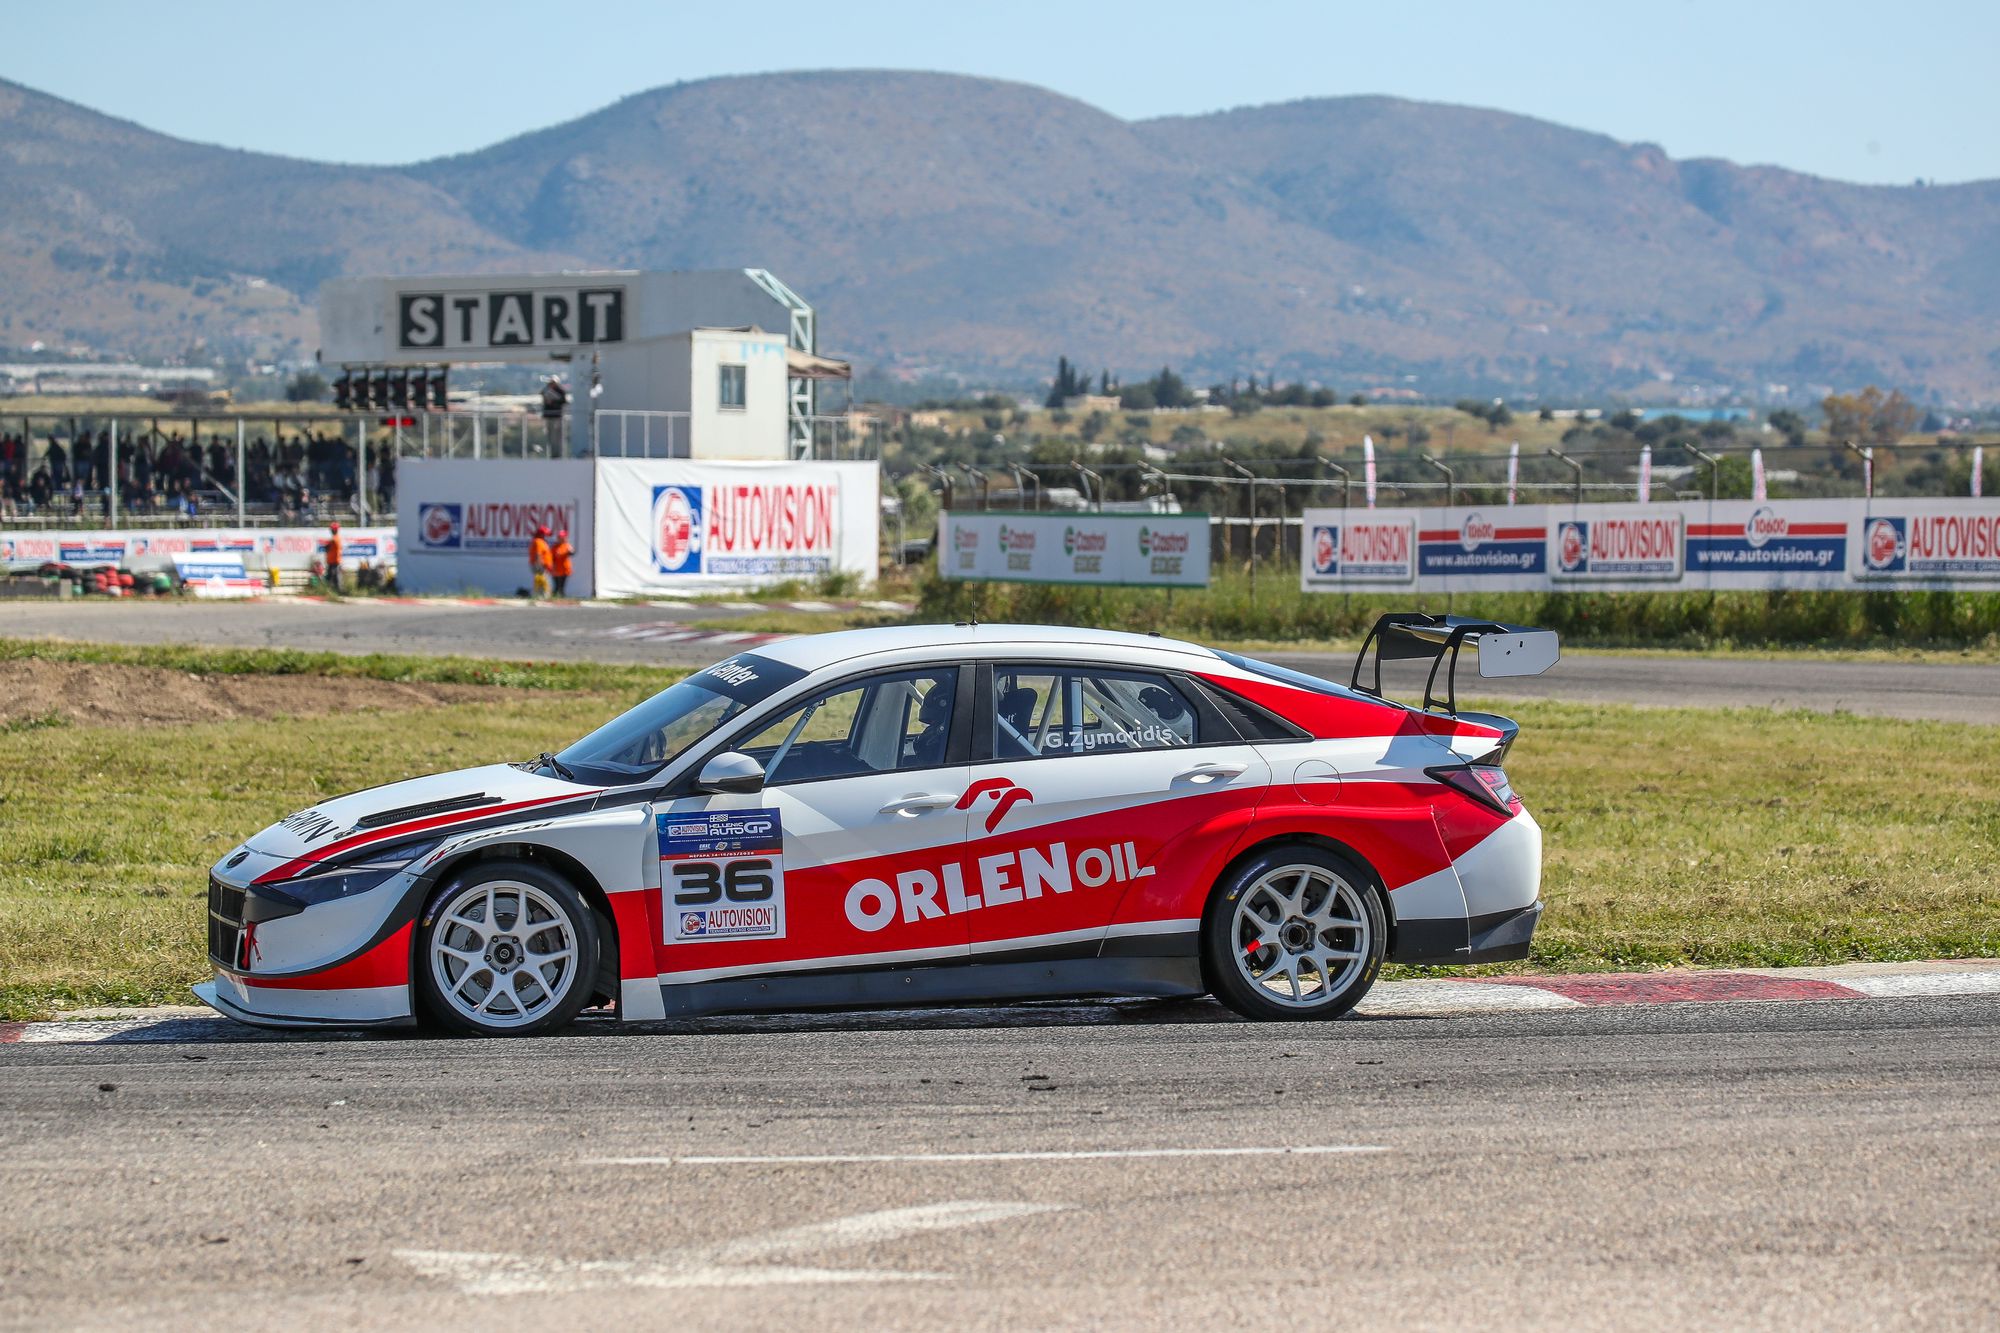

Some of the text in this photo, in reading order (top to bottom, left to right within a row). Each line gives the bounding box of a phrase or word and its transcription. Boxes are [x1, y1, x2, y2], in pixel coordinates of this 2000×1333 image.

[407, 293, 616, 346] START
[464, 503, 569, 538] AUTOVISION
[708, 485, 832, 551] AUTOVISION
[1755, 518, 1785, 534] 10600
[1008, 529, 1036, 549] Castrol
[1076, 530, 1107, 552] Castrol
[1152, 531, 1188, 553] Castrol
[1467, 523, 1493, 539] 10600
[1591, 520, 1674, 560] AUTOVISION
[1341, 525, 1408, 562] AUTOVISION
[1074, 555, 1102, 573] EDGE
[1151, 556, 1183, 574] EDGE
[1426, 551, 1536, 568] www.autovision.gr
[1697, 547, 1833, 566] www.autovision.gr
[1045, 725, 1172, 750] G.Zymaridis
[672, 859, 773, 906] 36
[844, 842, 1072, 931] ORLEN
[1076, 842, 1155, 887] OIL
[708, 908, 771, 928] AUTOVISION
